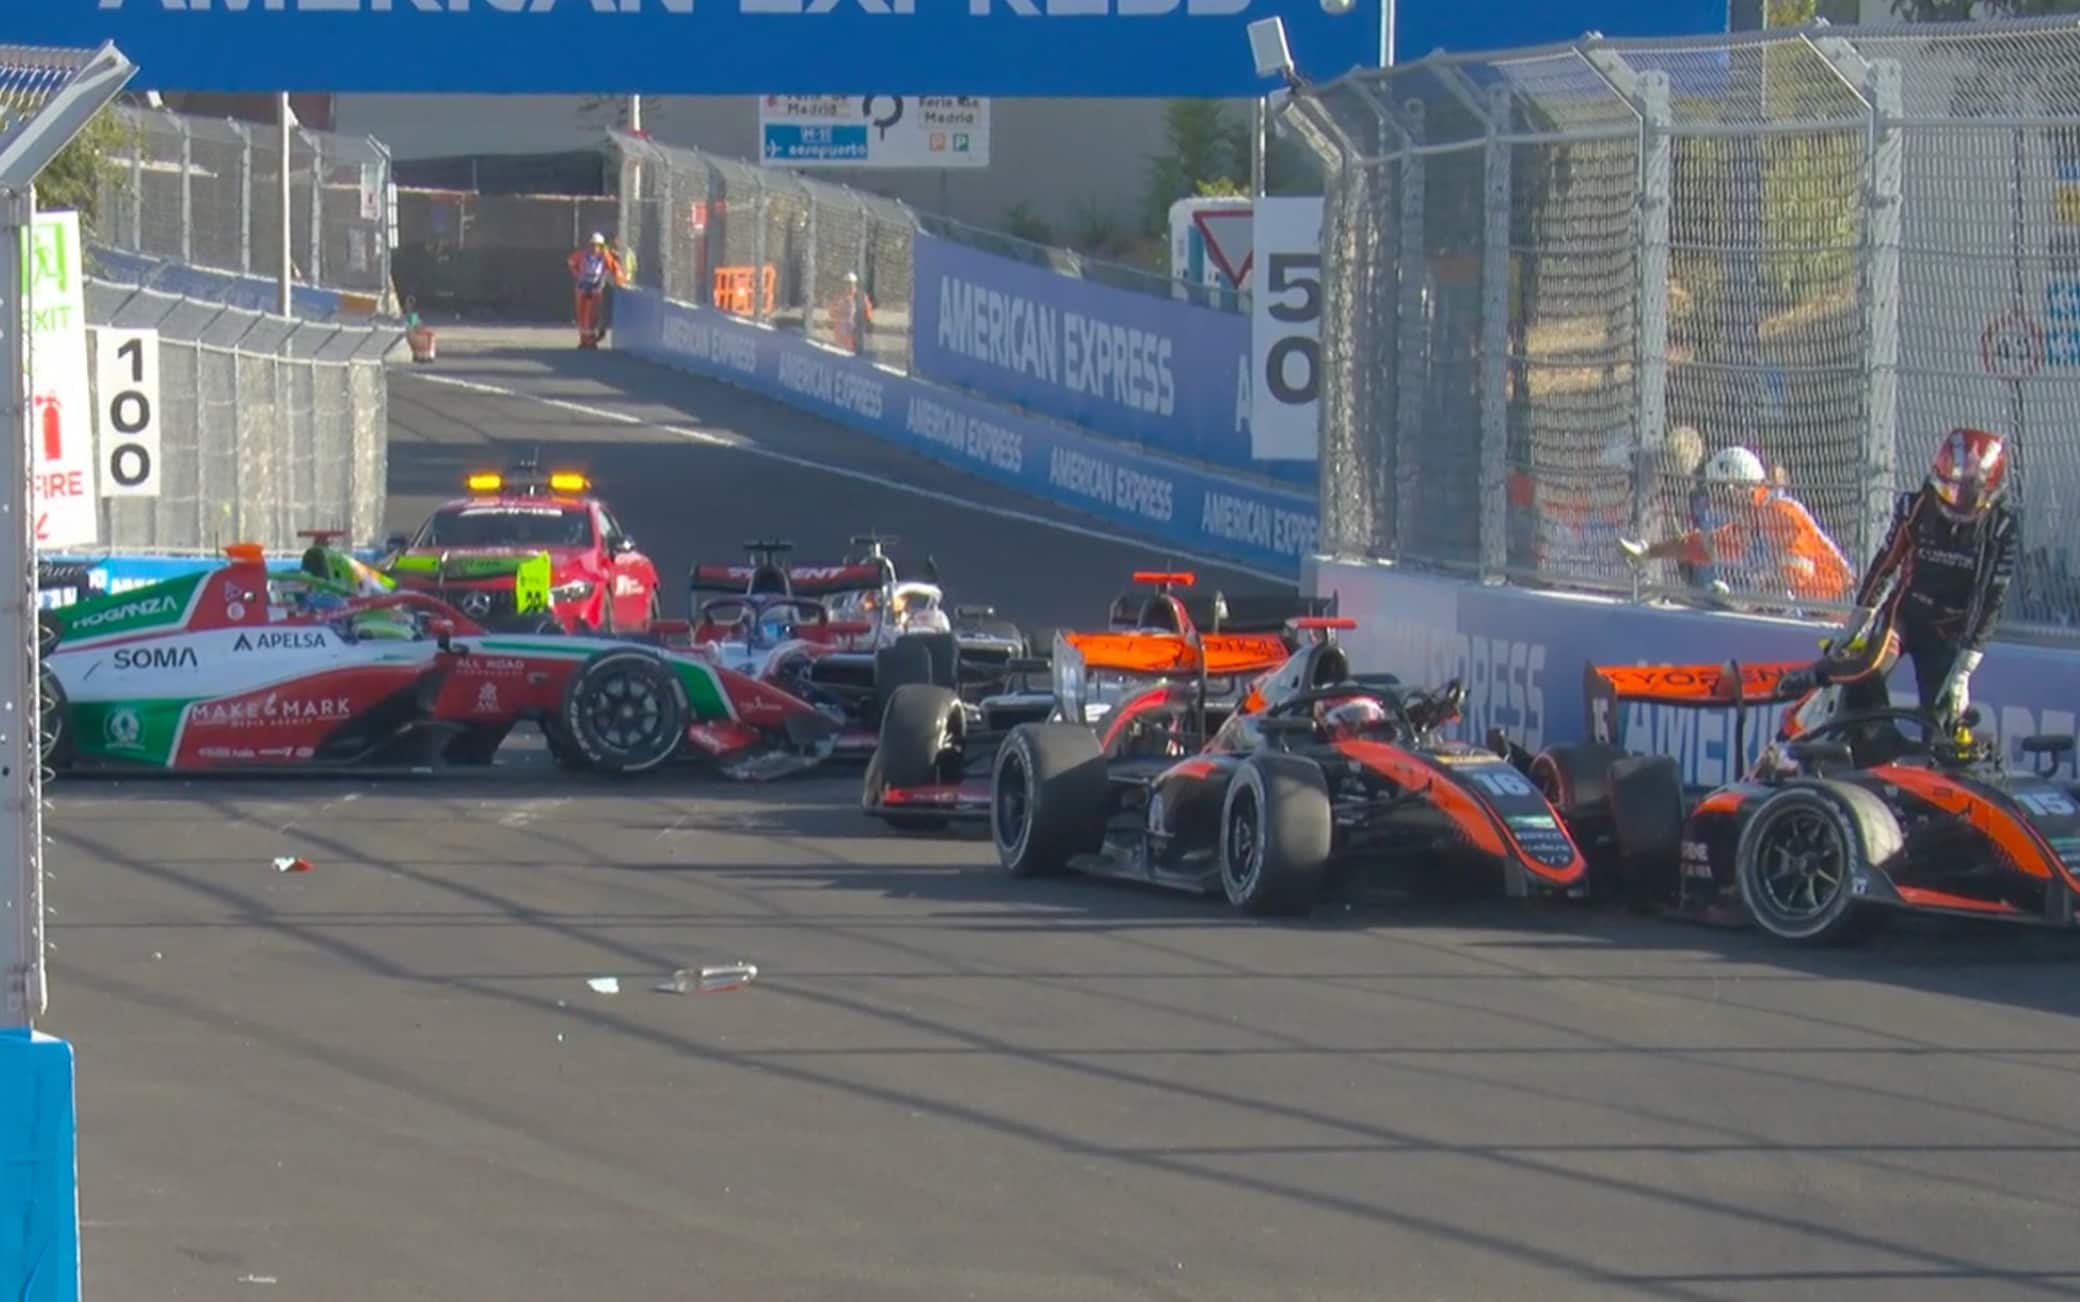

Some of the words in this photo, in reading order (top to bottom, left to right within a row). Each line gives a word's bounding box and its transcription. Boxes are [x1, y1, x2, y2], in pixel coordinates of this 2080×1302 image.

[938, 275, 1058, 385] AMERICAN
[1064, 311, 1175, 417] EXPRESS
[1265, 253, 1322, 405] 50
[110, 337, 151, 487] 100
[967, 416, 1023, 473] EXPRESS
[1050, 446, 1113, 504] AMERICAN
[1115, 466, 1174, 521] EXPRESS
[1201, 491, 1273, 548] AMERICAN
[113, 648, 198, 670] SOMA
[257, 632, 326, 649] APELSA
[191, 702, 260, 721] MAKE
[282, 697, 351, 718] MARK
[1472, 772, 1531, 796] 16
[2014, 792, 2075, 816] 15
